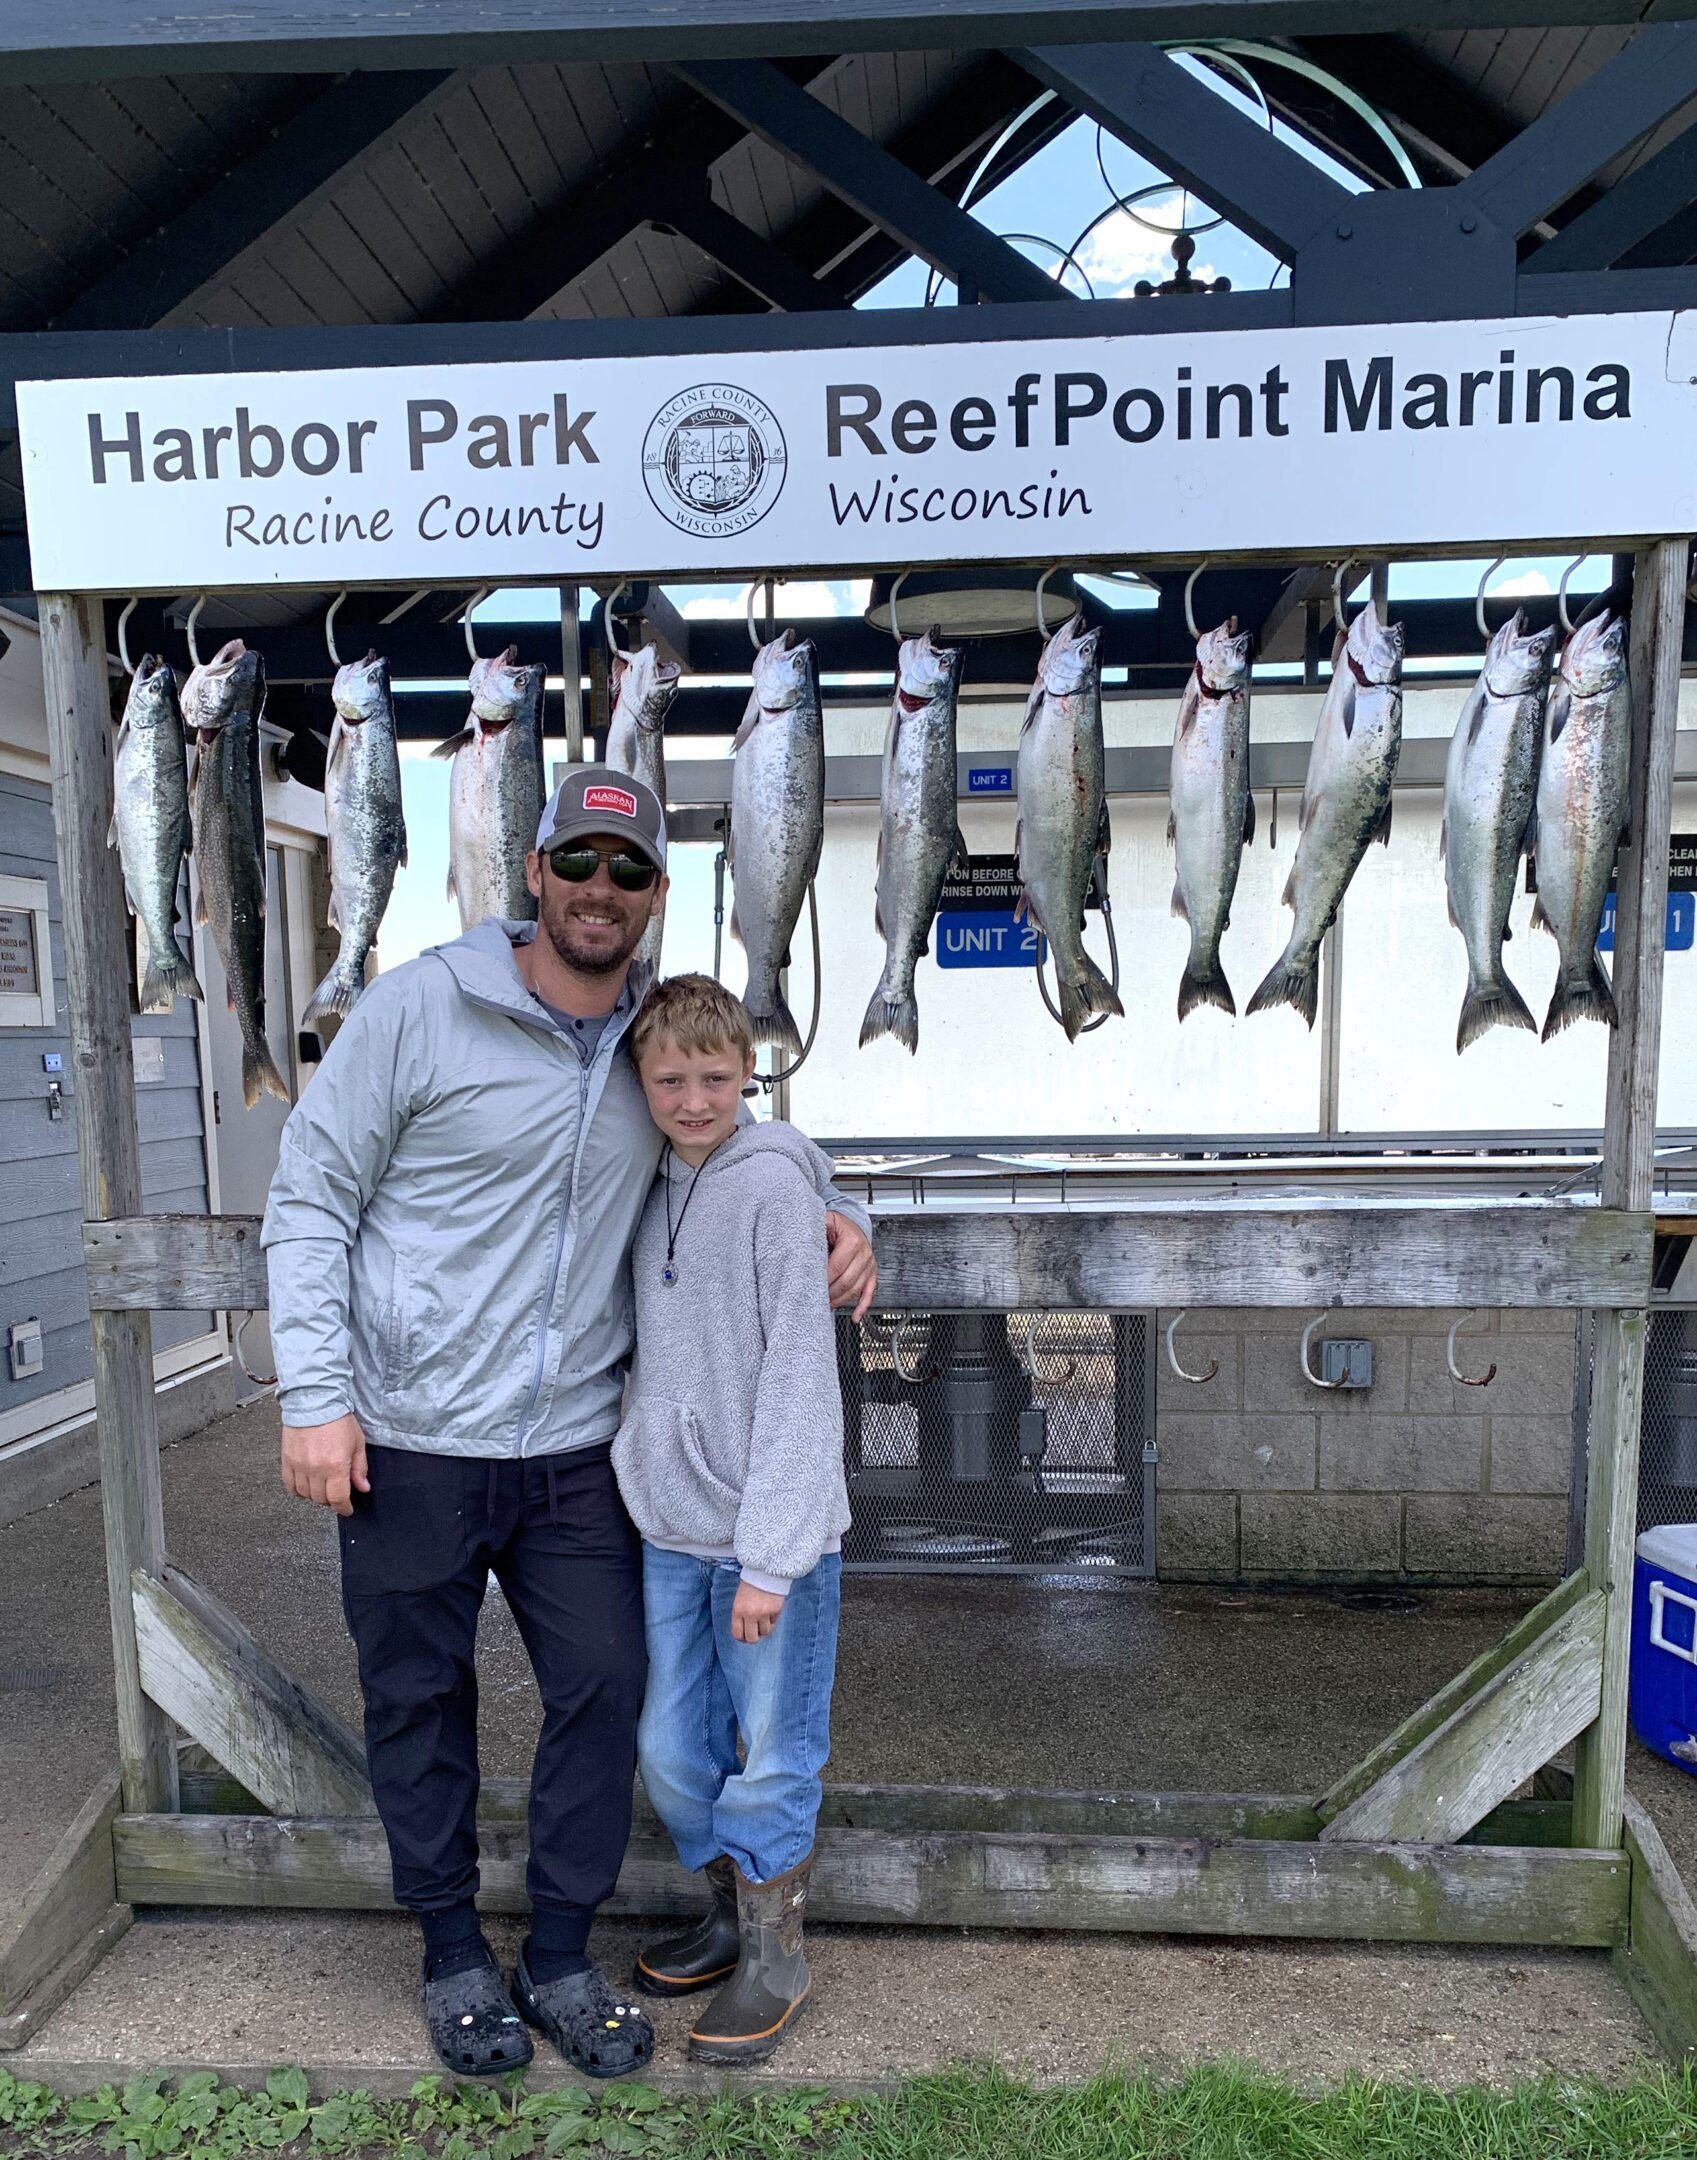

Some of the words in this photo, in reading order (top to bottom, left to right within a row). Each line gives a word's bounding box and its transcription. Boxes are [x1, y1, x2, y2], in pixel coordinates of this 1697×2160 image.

[658, 389, 707, 428] RACINE
[712, 388, 771, 424] COUNTY
[825, 364, 1290, 458] ReefPoint
[1323, 349, 1632, 434] Marina
[690, 410, 736, 424] FORWARD
[87, 406, 378, 484] Harbor
[406, 393, 601, 471] Park
[828, 469, 1093, 526] Wisconsin
[226, 496, 394, 548] Racine
[418, 492, 604, 550] County
[676, 507, 759, 533] WISCONSIN
[972, 775, 996, 785] UNIT
[1000, 774, 1007, 784] 2
[587, 792, 633, 812] ALASKAN
[954, 869, 969, 880] ON
[972, 868, 1014, 881] BEFORE
[1669, 866, 1692, 877] HEN
[942, 885, 973, 897] RINSE
[975, 885, 1008, 897] DOWN
[1673, 909, 1681, 933] 1
[946, 928, 1008, 952] UNIT
[1020, 927, 1037, 950] 2
